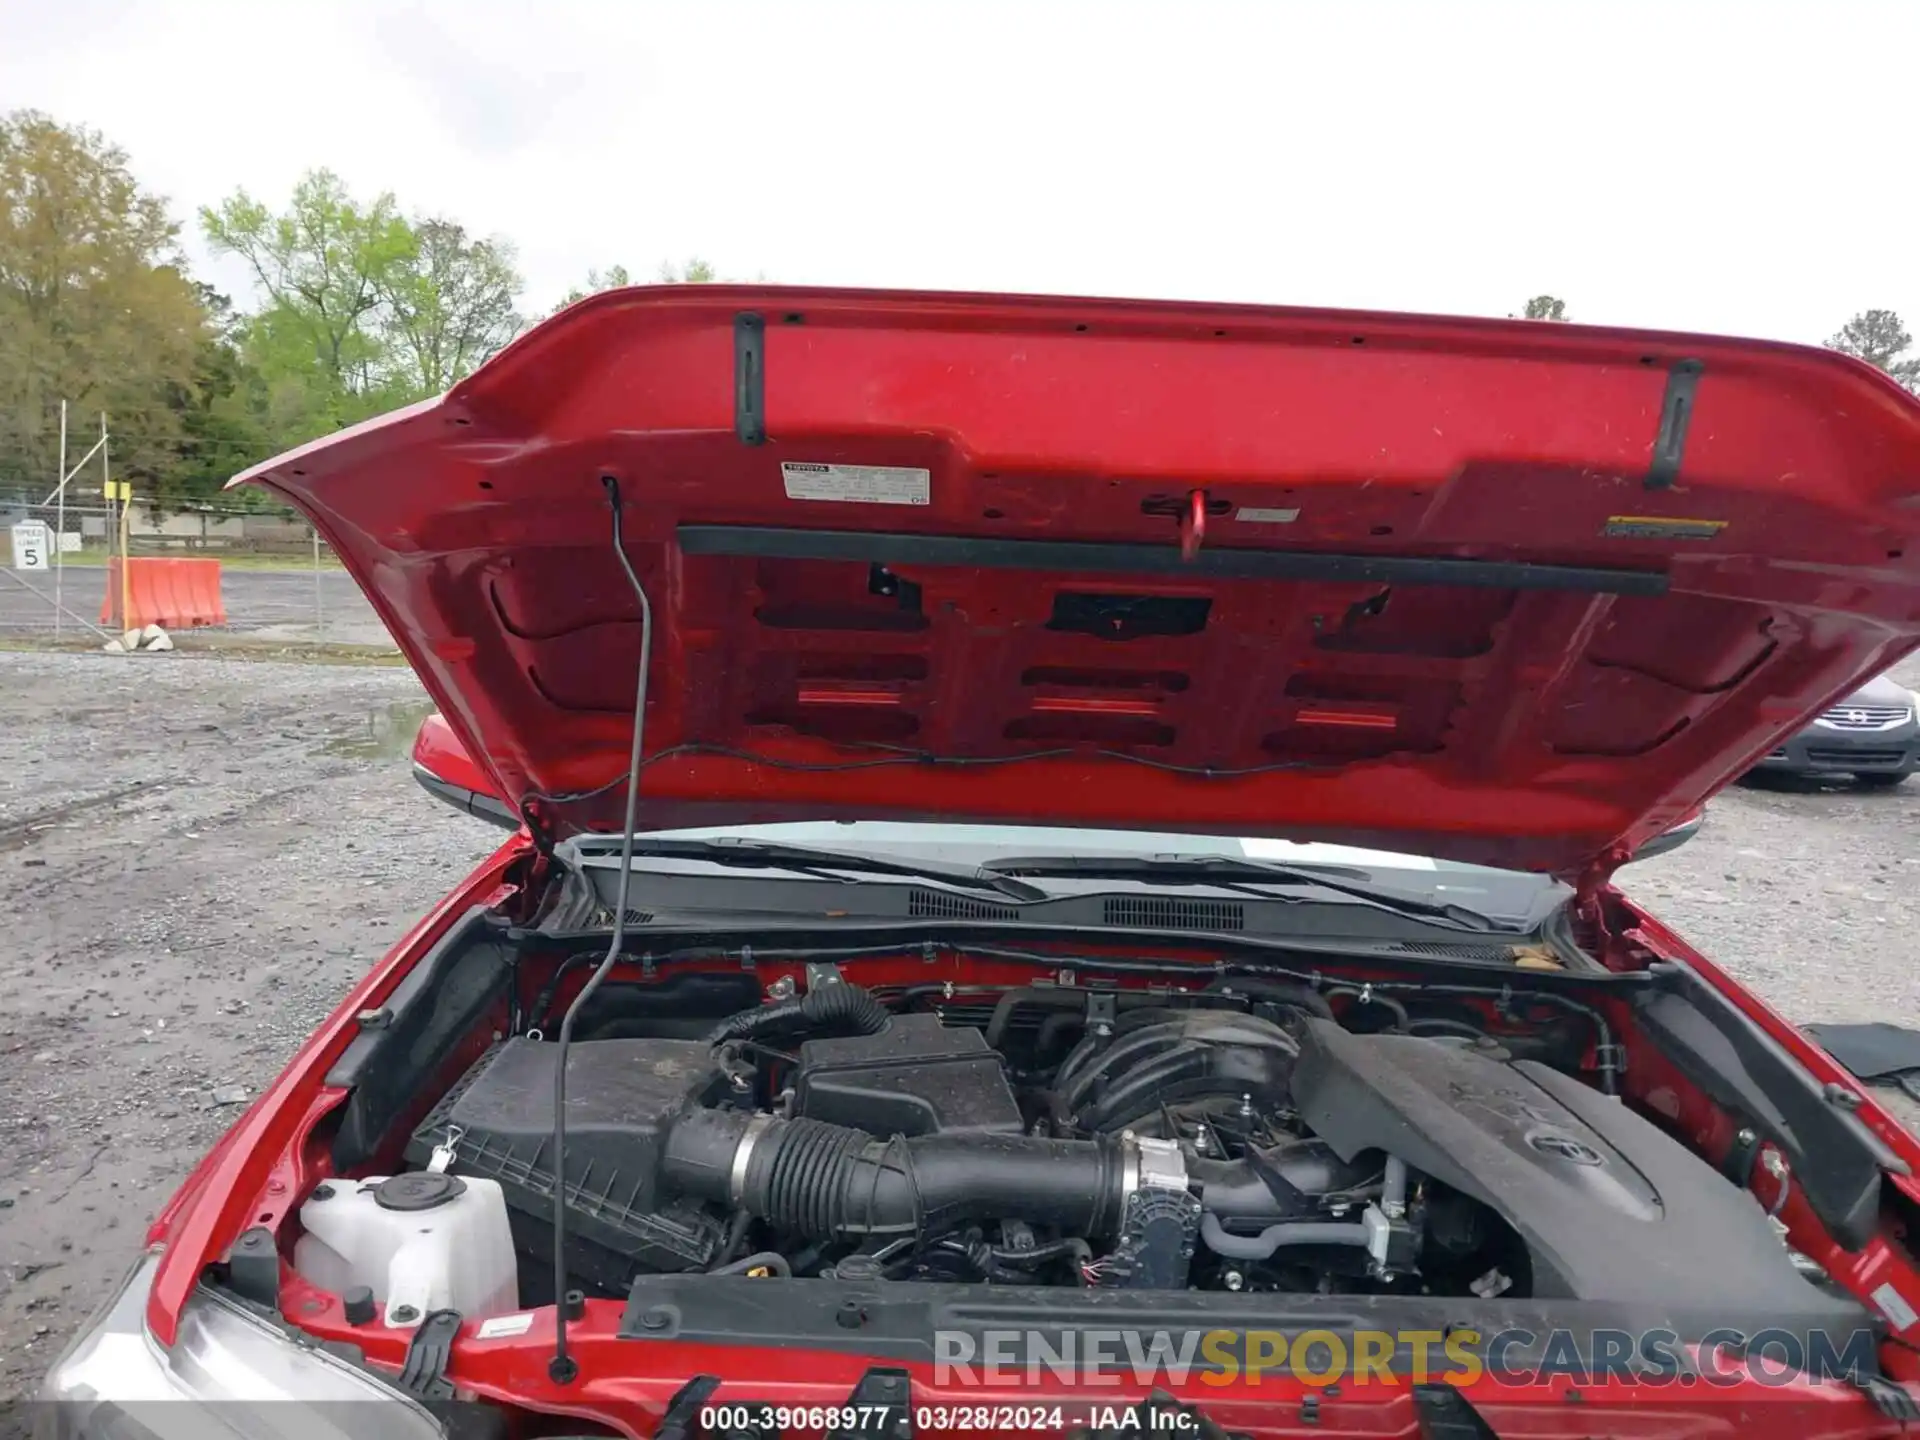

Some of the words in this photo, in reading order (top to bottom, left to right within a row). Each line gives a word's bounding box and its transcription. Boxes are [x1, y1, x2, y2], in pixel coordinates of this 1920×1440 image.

[15, 528, 44, 537] SPEED
[18, 538, 41, 546] LIMIT
[24, 549, 39, 566] 5
